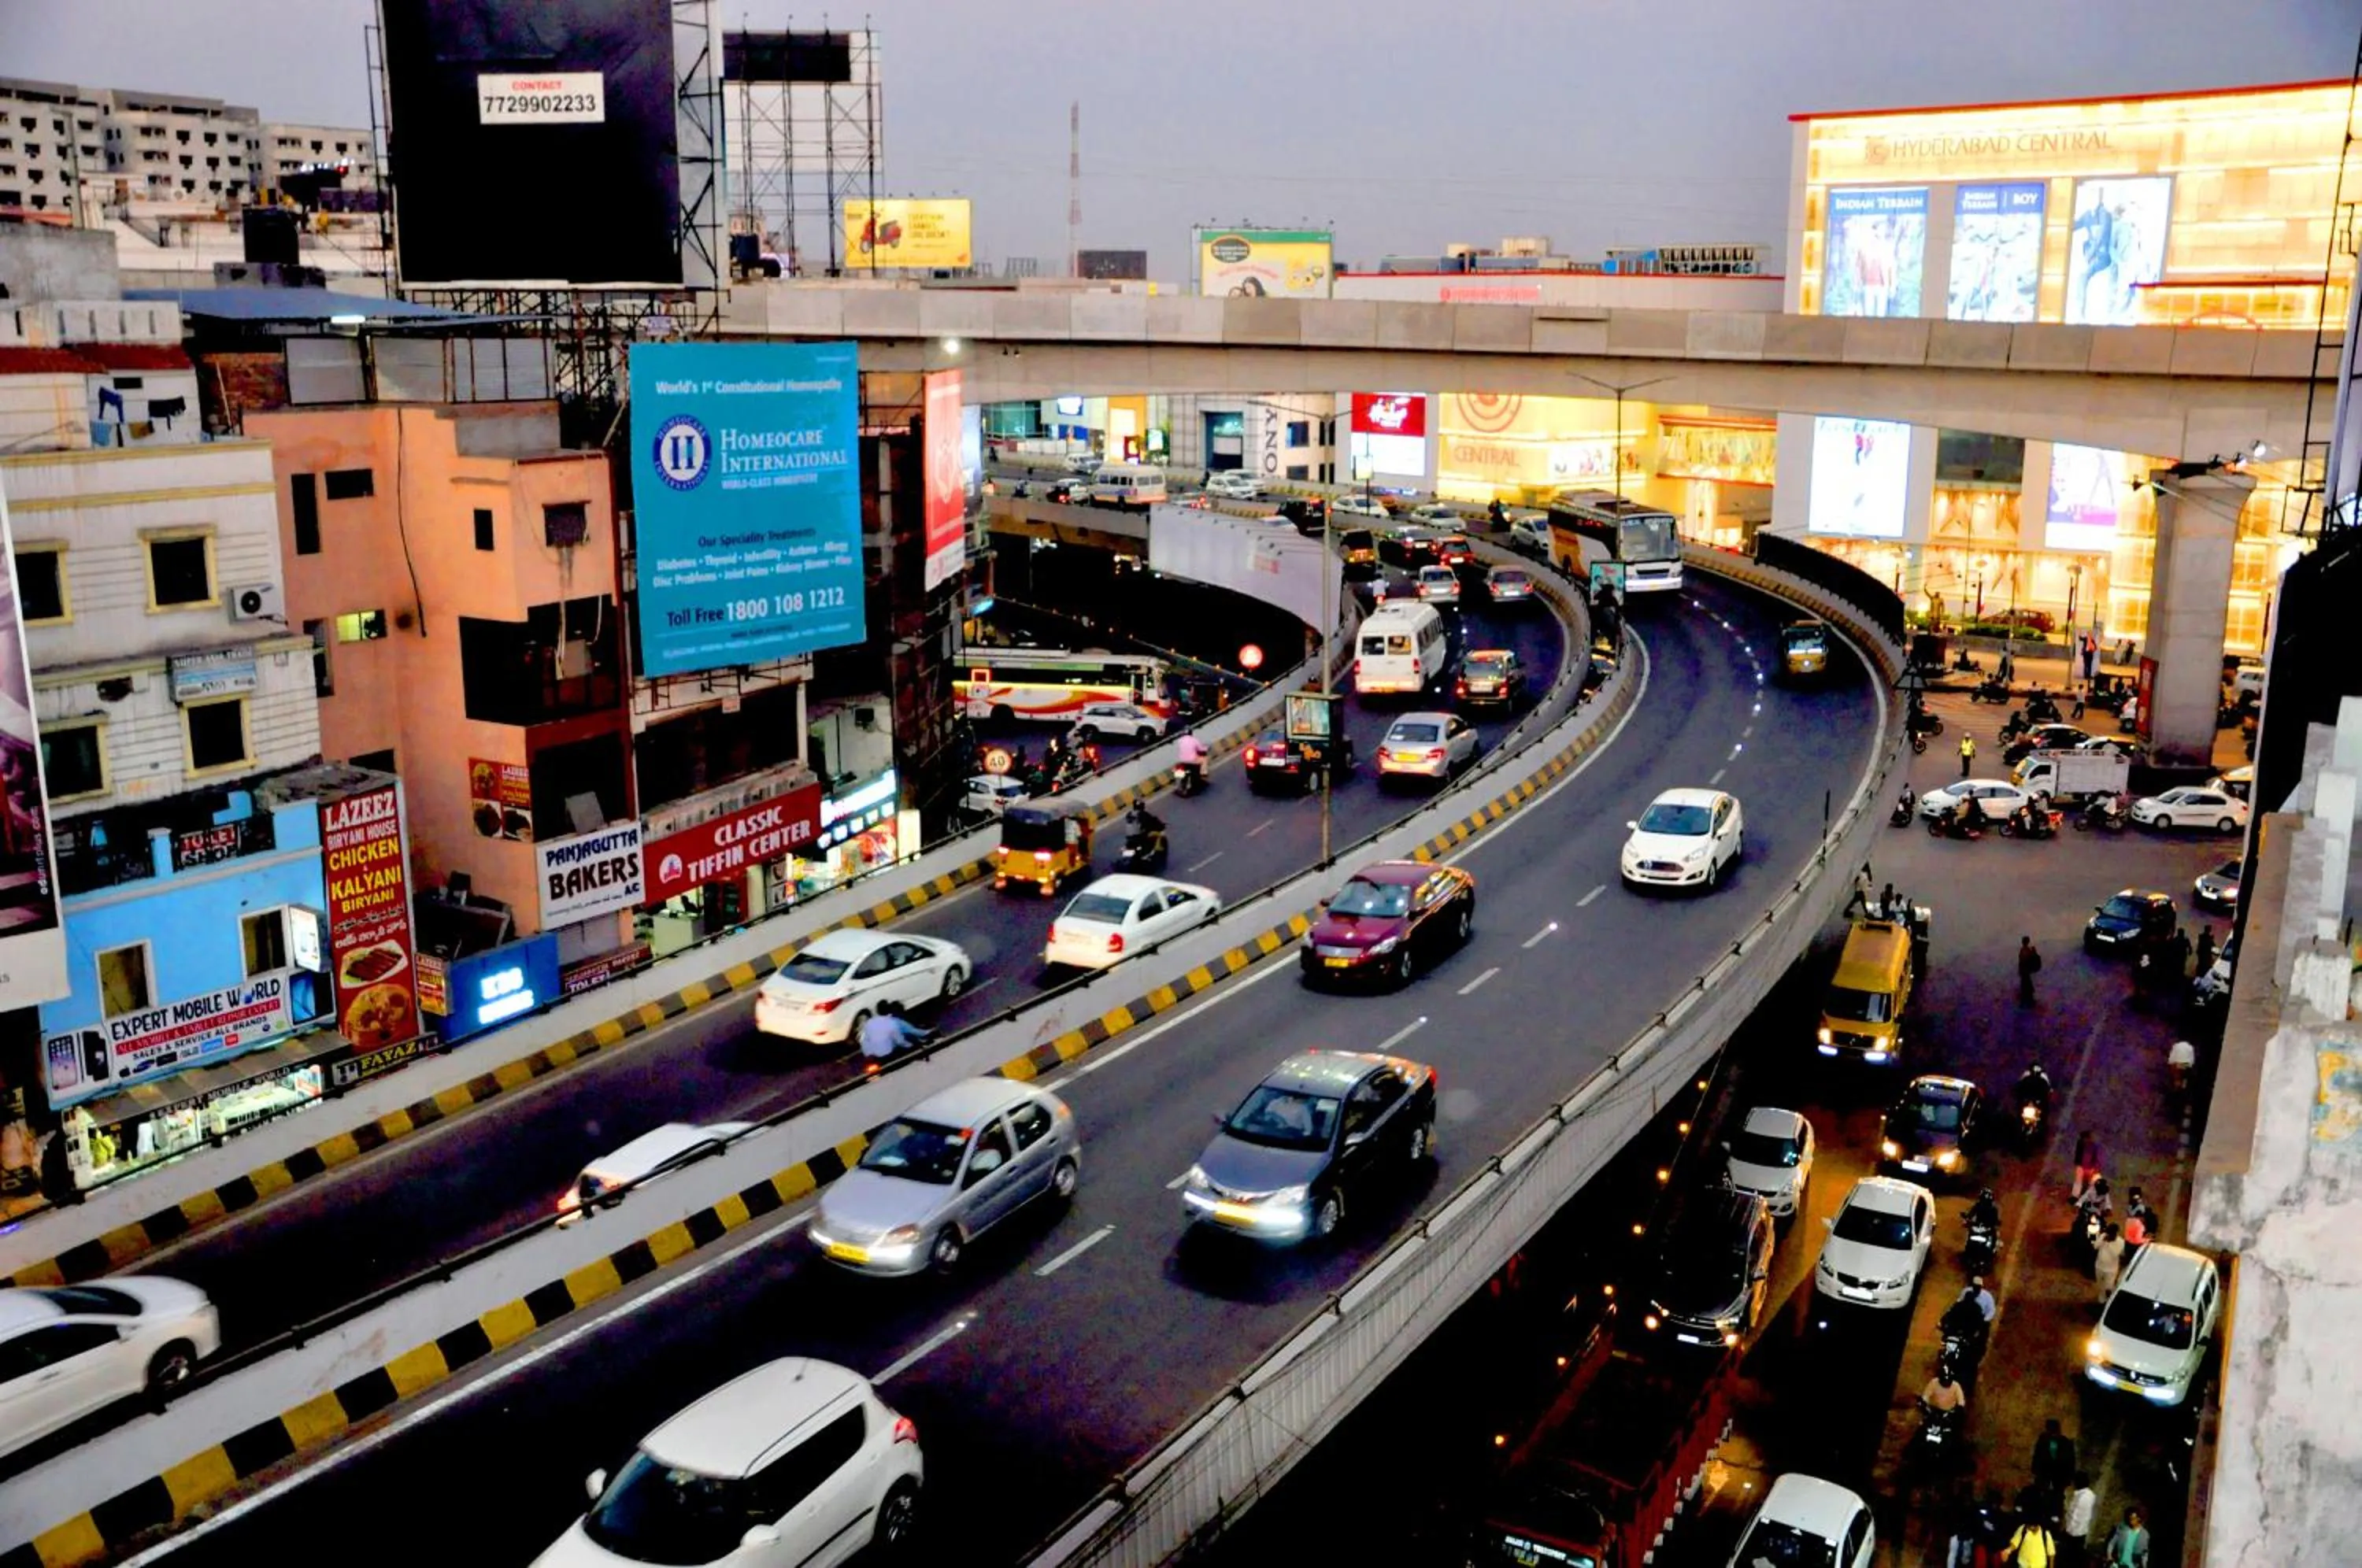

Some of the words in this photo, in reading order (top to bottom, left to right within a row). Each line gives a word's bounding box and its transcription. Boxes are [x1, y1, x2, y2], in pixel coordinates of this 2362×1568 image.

[512, 80, 563, 91] CONTACT
[483, 94, 596, 113] 7729902233
[1892, 135, 2011, 158] HYDERABAD
[2016, 131, 2115, 153] CENTRAL
[1877, 196, 1923, 210] TERRAIN
[2012, 192, 2039, 205] BOY
[655, 380, 698, 394] World's
[1264, 407, 1279, 473] ONY
[720, 449, 848, 474] INTERNATIONAL
[1453, 446, 1520, 467] CENTRAL
[698, 534, 717, 548] Our
[720, 531, 765, 548] Speciality
[667, 607, 691, 627] Toll
[694, 605, 724, 623] Free
[726, 597, 768, 621] 1800
[774, 592, 804, 615] 108
[809, 586, 845, 610] 1212
[324, 790, 395, 832] LAZEEZ
[714, 805, 783, 847] CLASSIC
[326, 828, 365, 851] BIRYANI
[366, 819, 398, 841] HOUSE
[546, 828, 638, 867] PANJAGUTTA
[328, 836, 400, 871] CHICKEN
[687, 844, 744, 883] TIFFIN
[749, 819, 811, 857] CENTER
[331, 866, 402, 901] KALYANI
[549, 852, 639, 900] BAKERS
[341, 887, 394, 914] BIRYANI
[112, 1008, 169, 1041] EXPERT
[173, 993, 224, 1023] MOBILE
[174, 1031, 213, 1049] SERVICE
[361, 1041, 416, 1071] FAYAZ
[206, 1079, 252, 1101] MOBILE
[254, 1067, 291, 1085] WORLD
